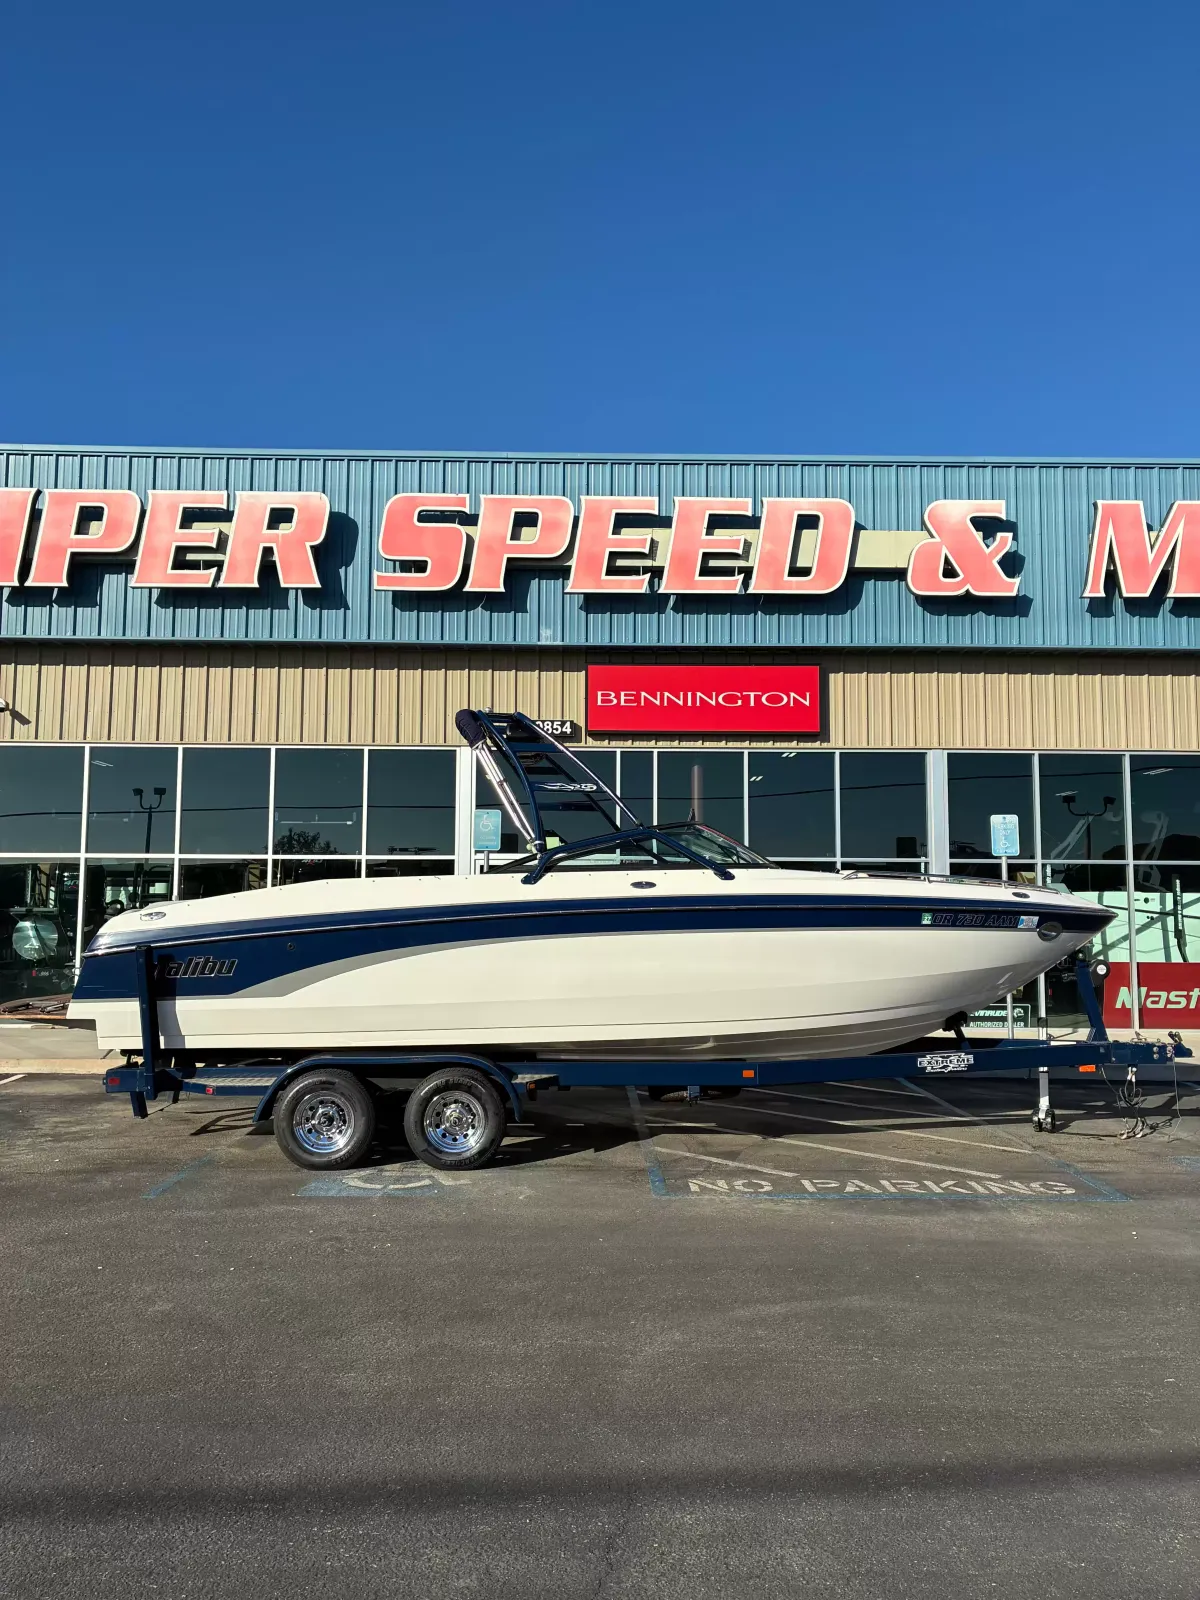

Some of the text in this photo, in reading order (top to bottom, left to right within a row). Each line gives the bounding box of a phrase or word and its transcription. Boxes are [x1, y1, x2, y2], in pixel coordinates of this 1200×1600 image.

[373, 493, 856, 595] SPEED
[907, 500, 1021, 596] &
[596, 690, 811, 707] BENNINGTON
[956, 914, 986, 926] 730
[917, 1056, 974, 1067] EXTREME
[688, 1178, 1077, 1195] NO PARKING
